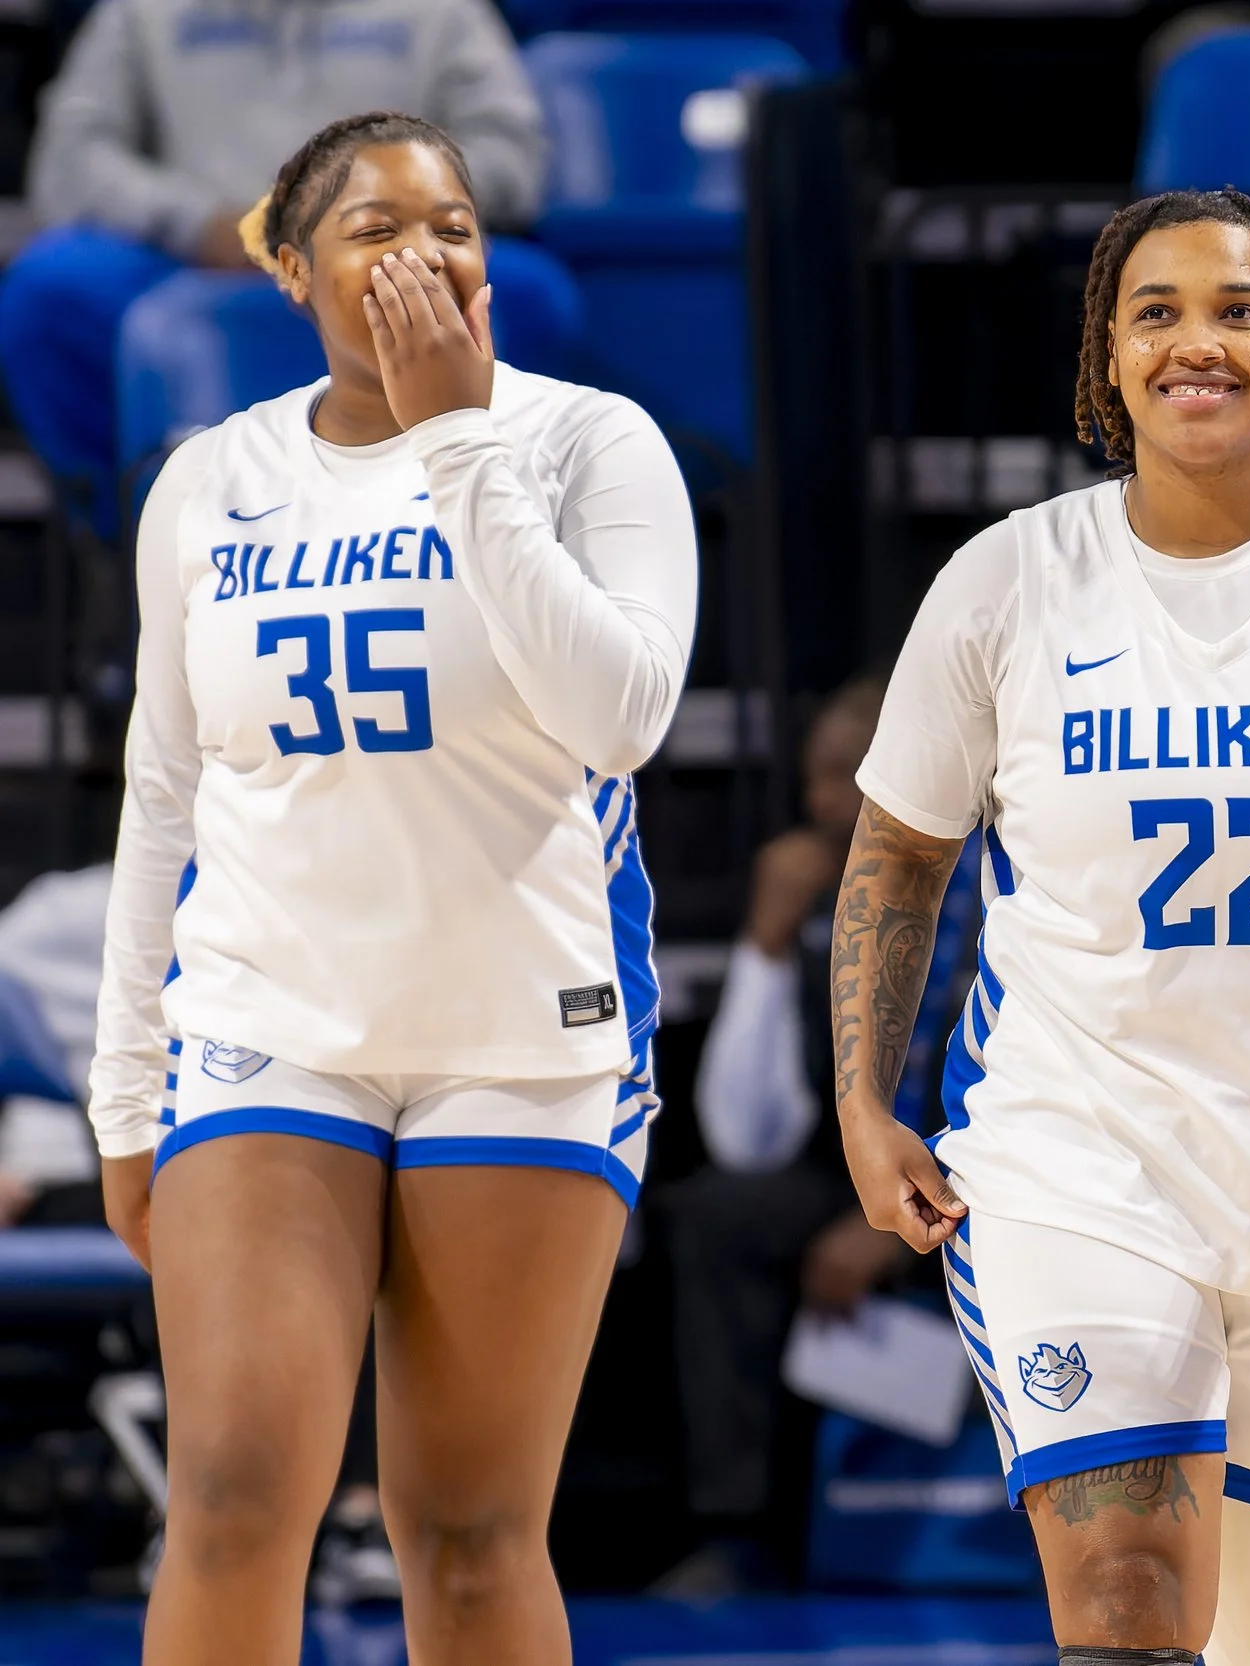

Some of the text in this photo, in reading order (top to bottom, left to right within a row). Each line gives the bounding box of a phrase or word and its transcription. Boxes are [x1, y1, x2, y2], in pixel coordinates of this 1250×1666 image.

[211, 525, 454, 602] BILLIKEN
[256, 607, 433, 756] 35
[602, 993, 614, 1010] XL
